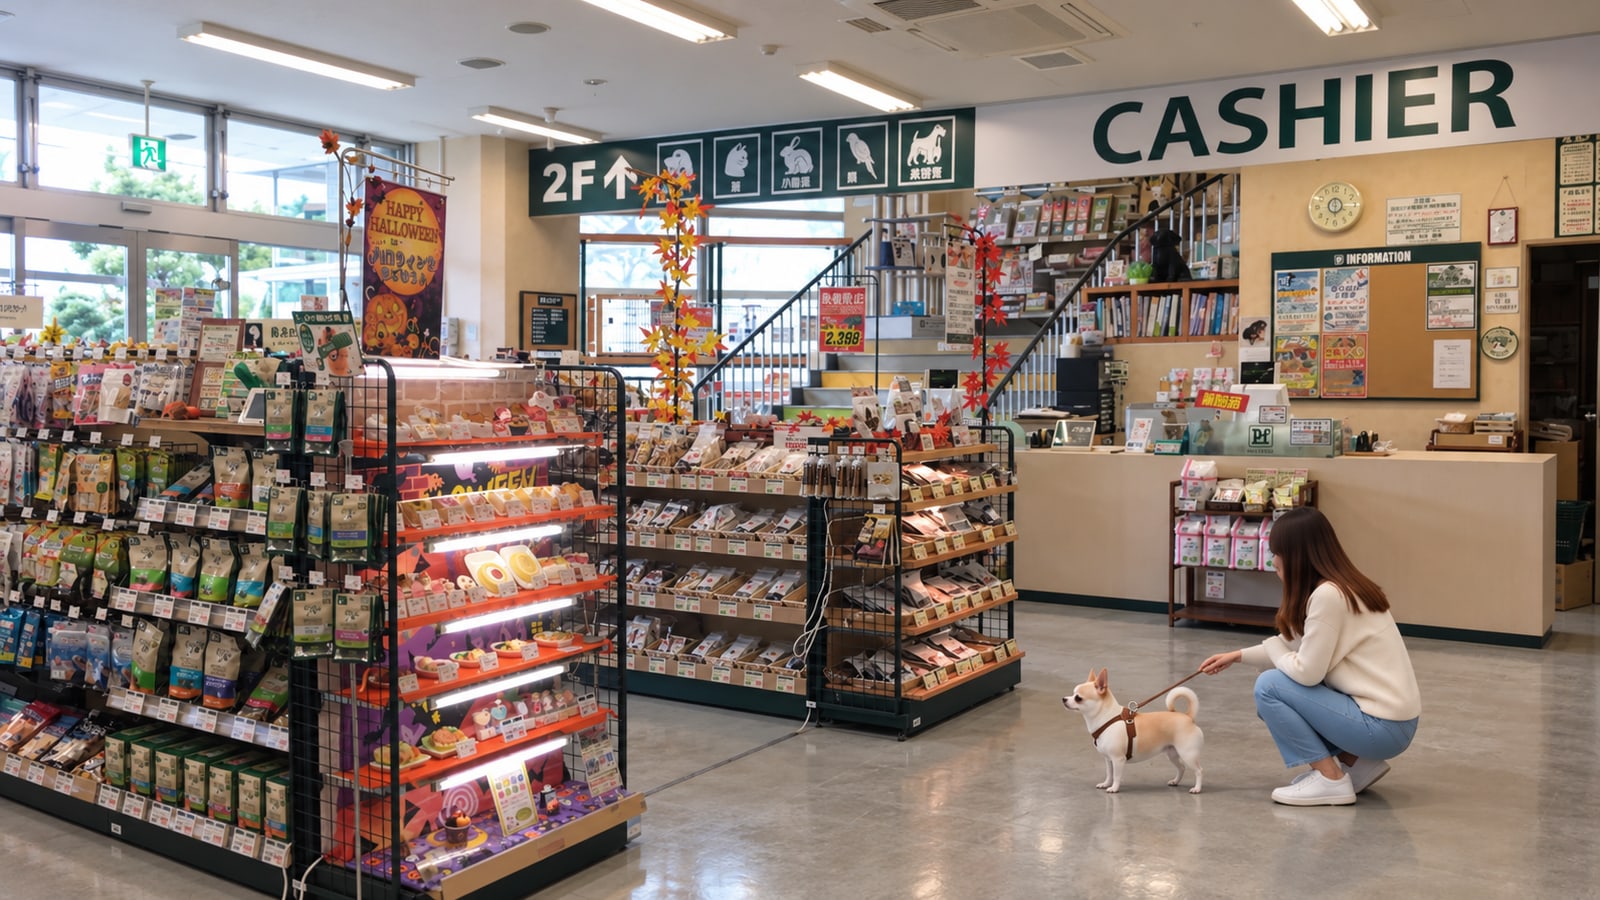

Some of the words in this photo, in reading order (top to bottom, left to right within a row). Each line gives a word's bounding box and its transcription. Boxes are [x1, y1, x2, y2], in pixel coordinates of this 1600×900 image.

[1092, 59, 1516, 164] CASHIER
[542, 160, 596, 203] 2F
[386, 200, 424, 223] HAPPY
[1346, 250, 1412, 265] INFORMATION
